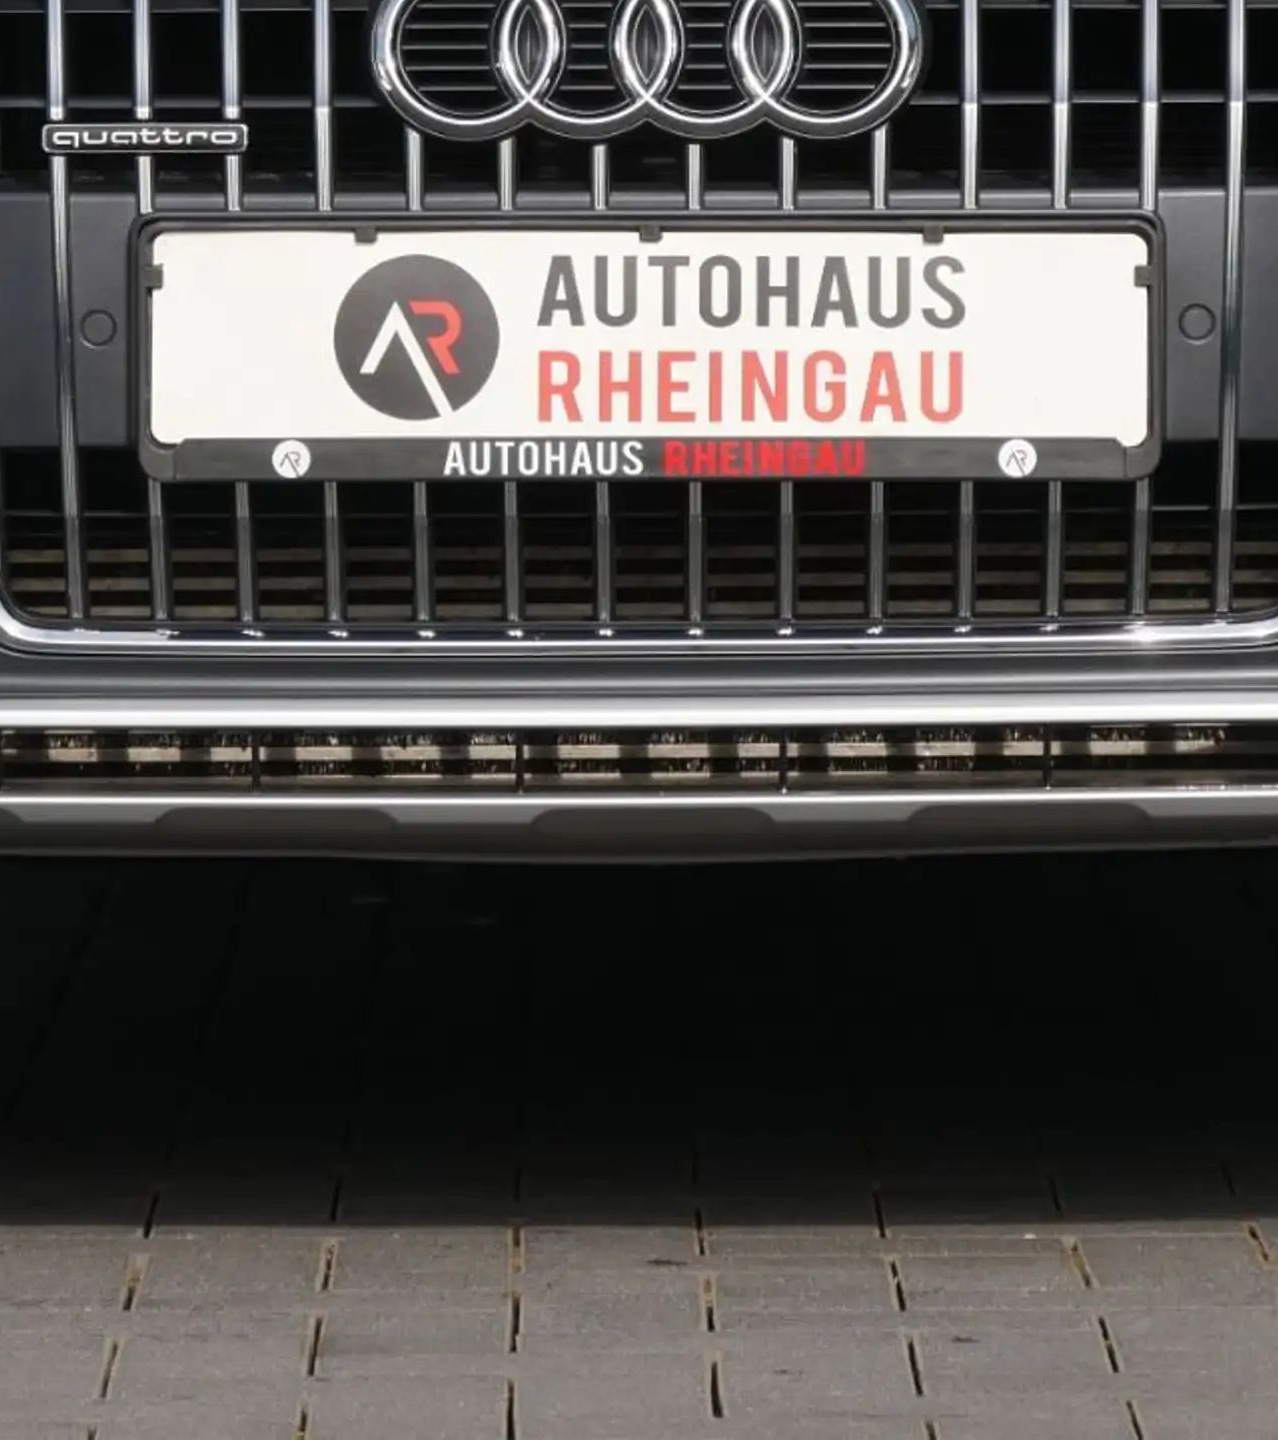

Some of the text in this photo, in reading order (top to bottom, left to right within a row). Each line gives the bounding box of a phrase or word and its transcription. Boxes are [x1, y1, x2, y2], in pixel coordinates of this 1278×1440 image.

[51, 127, 239, 149] quattro
[536, 255, 966, 329] AUTOHAUS
[536, 350, 964, 423] RHEINGAU
[442, 439, 867, 477] AUTOHAUS RHEINGAU
